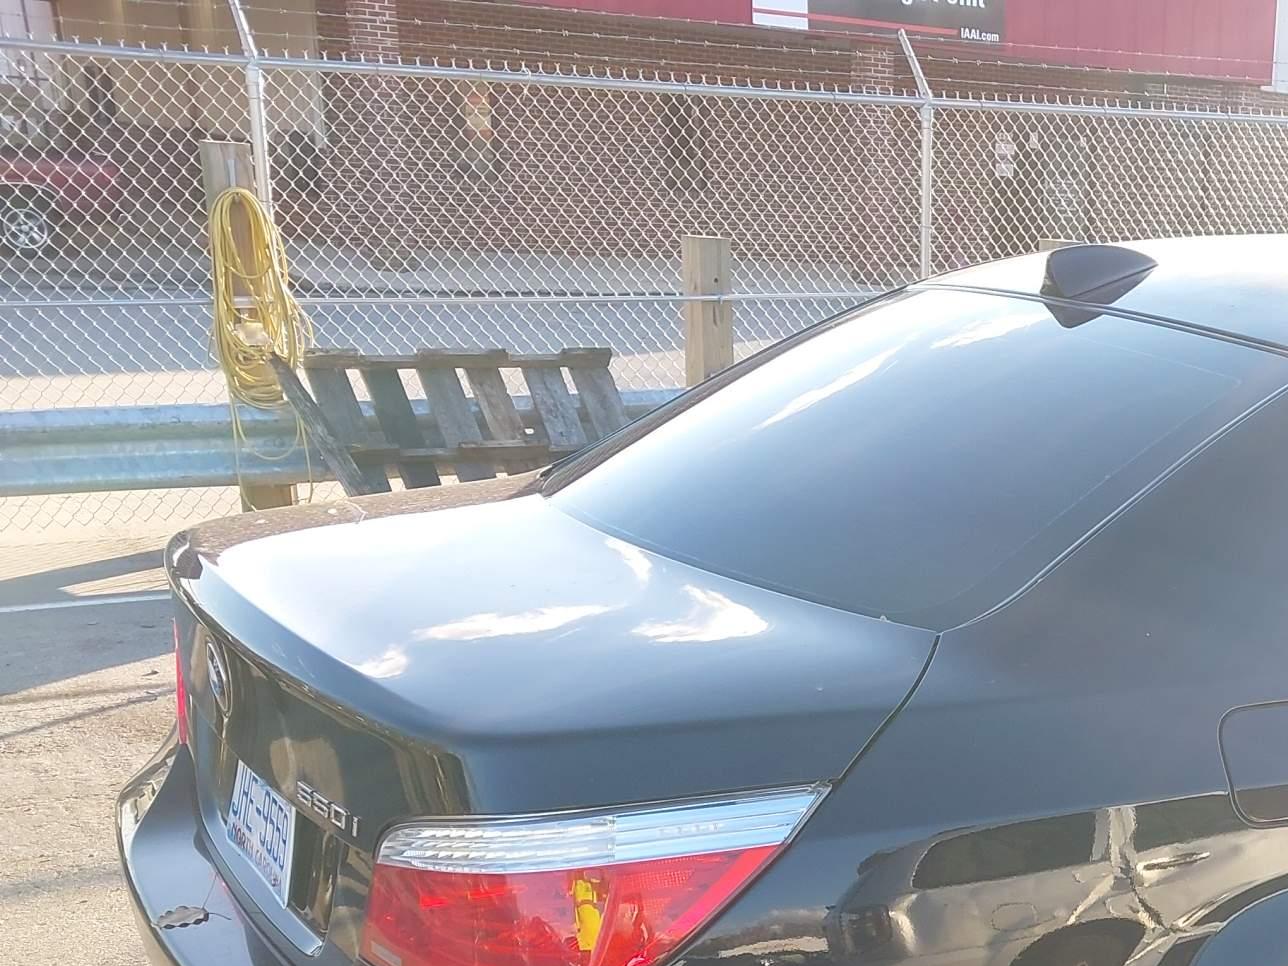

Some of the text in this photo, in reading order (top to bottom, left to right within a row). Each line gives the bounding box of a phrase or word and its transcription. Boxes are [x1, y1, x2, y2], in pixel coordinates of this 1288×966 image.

[961, 27, 999, 42] IAAI.com
[231, 765, 289, 872] JHE-9559
[231, 821, 255, 860] NORTH
